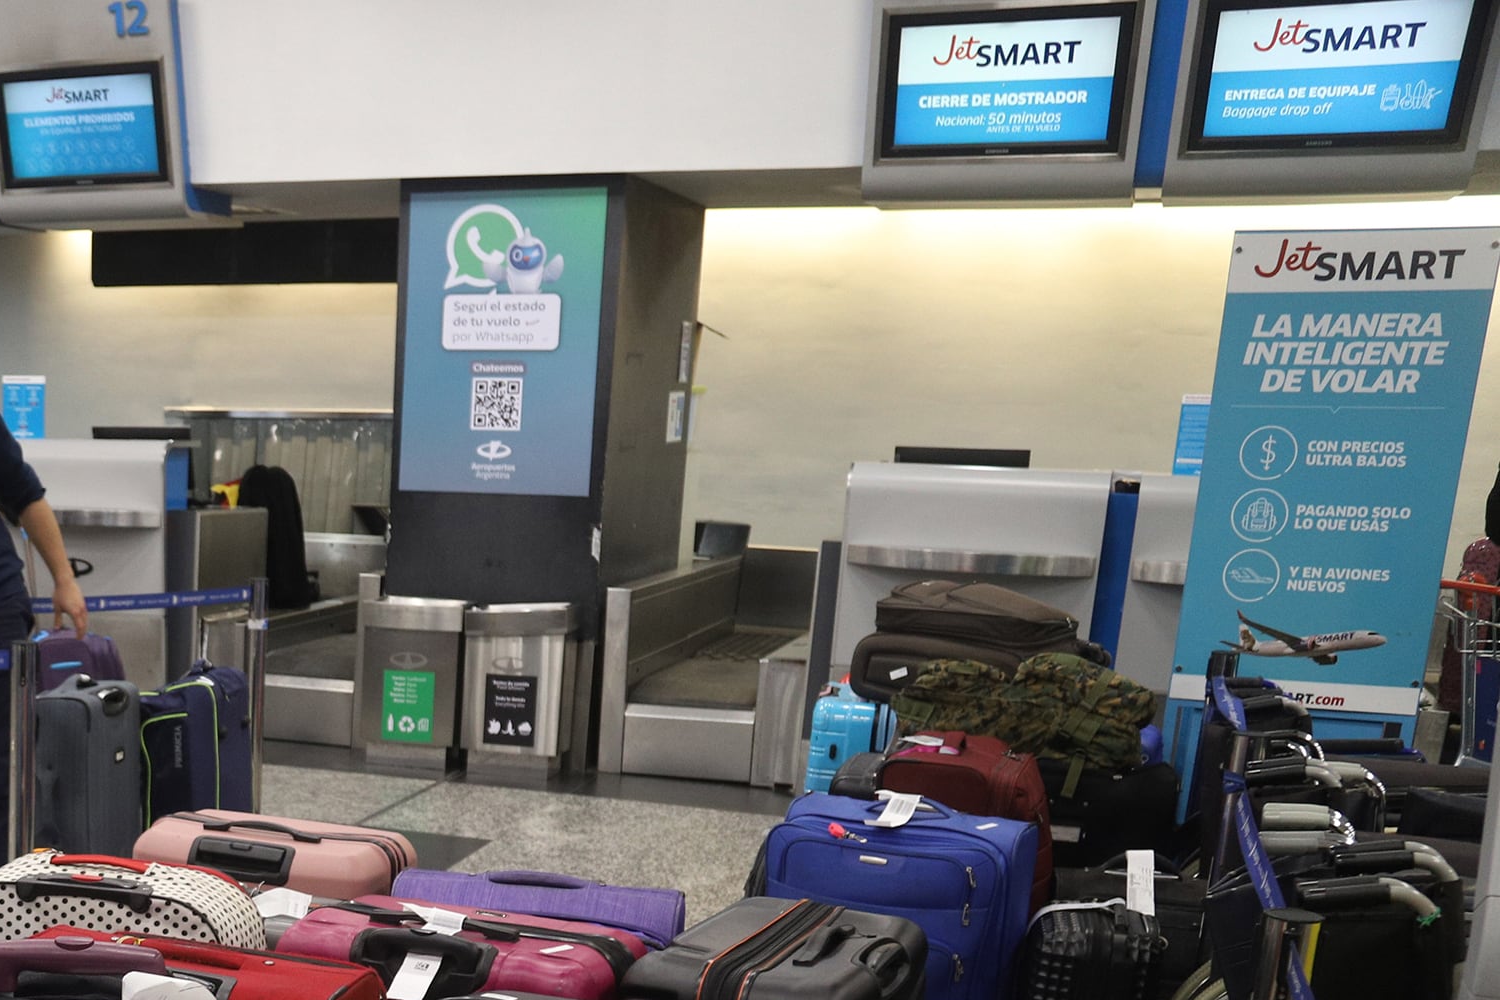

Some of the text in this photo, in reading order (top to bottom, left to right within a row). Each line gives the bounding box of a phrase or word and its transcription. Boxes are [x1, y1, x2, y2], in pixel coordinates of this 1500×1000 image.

[108, 0, 150, 37] 12
[1254, 18, 1427, 53] JetSMART
[933, 34, 1082, 67] JetSMART
[46, 87, 110, 103] JetSMART
[918, 90, 1088, 109] CIERRE DE MOSTRADOR
[1225, 84, 1376, 102] ENTREGA DE EQUIPAJE
[1222, 102, 1332, 119] Baggage drop off
[935, 111, 1061, 127] Nacional: 50 minutos
[986, 124, 1061, 133] ANTES DE TU VUELO
[1254, 238, 1466, 282] JetSMART
[490, 301, 501, 311] el
[504, 301, 546, 312] estado
[453, 316, 520, 327] de tu vuelo
[1252, 312, 1442, 338] LA MANERA
[452, 331, 534, 343] por Whatsapp
[1242, 340, 1449, 366] INTELIGENTE
[1259, 369, 1420, 394] DE VOLAR
[1307, 440, 1405, 454] CON PRECIOS
[1305, 454, 1407, 468] ULTRA BAJOS
[1296, 505, 1411, 520] PAGANDO SOLO
[1293, 518, 1312, 531] LO
[1316, 519, 1347, 532] QUE
[1289, 566, 1391, 582] Y EN AVIONES
[1286, 580, 1346, 593] NUEVOS
